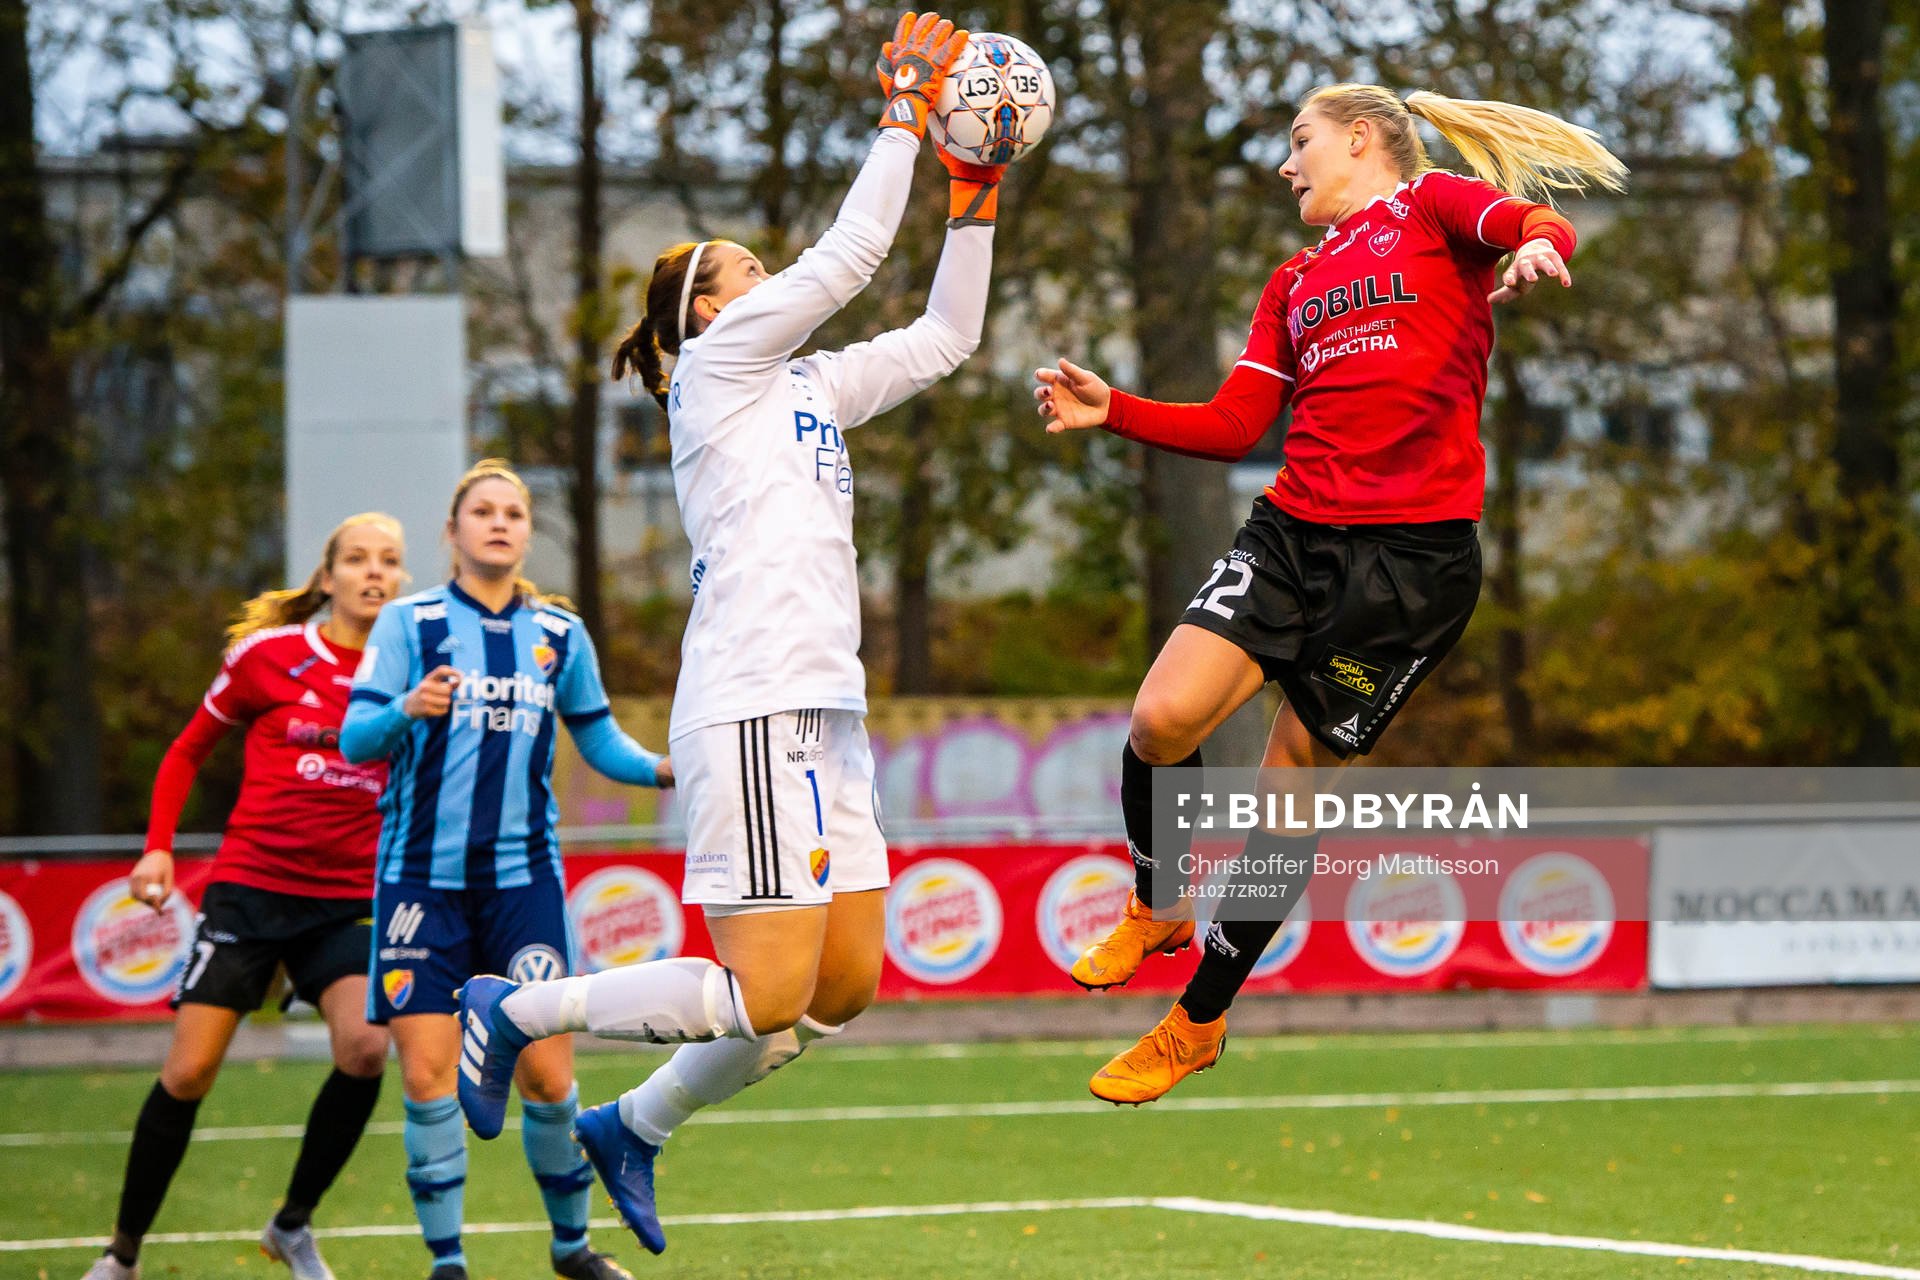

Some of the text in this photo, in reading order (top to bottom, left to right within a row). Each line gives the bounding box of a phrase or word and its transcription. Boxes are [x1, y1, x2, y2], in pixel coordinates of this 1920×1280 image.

[1186, 559, 1253, 620] 22
[1330, 657, 1364, 677] Svedala
[1335, 670, 1375, 692] CarGo
[1331, 726, 1358, 744] SELECT
[806, 770, 823, 836] 1
